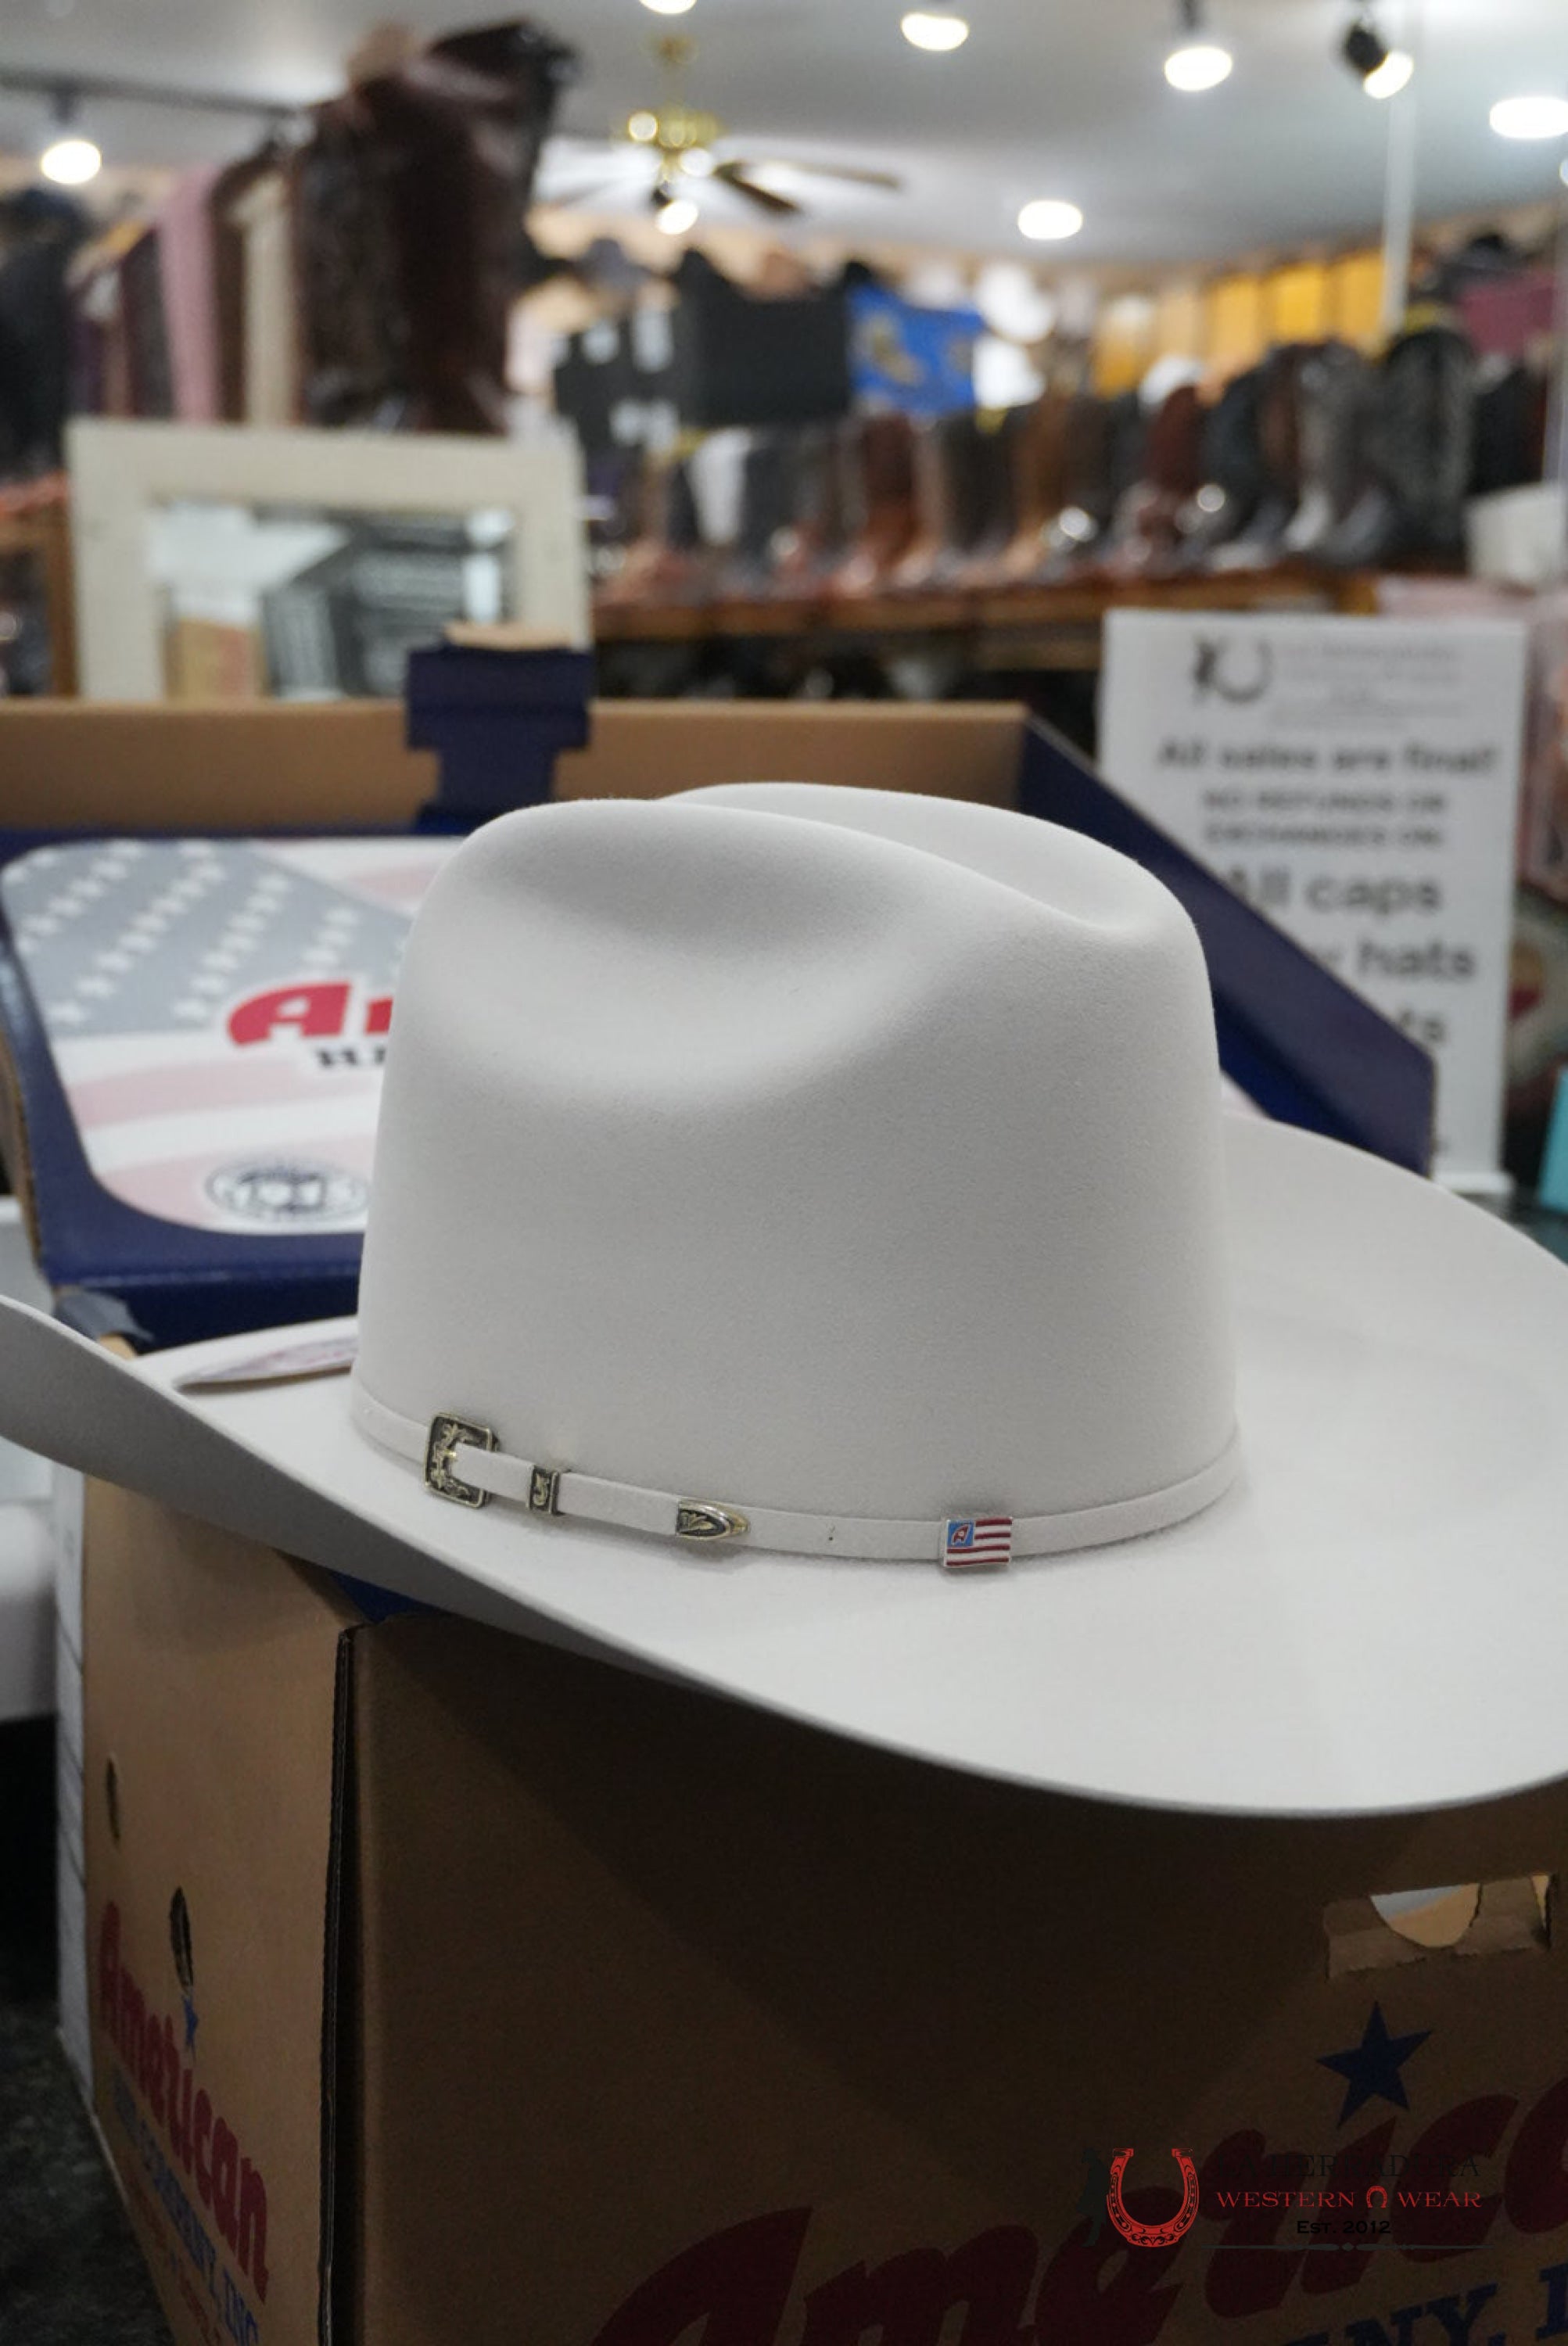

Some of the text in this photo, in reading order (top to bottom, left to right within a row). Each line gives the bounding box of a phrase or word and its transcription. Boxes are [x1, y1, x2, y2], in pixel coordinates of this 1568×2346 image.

[1332, 747, 1390, 771] are
[1305, 875, 1441, 914] caps
[1358, 940, 1477, 978] hats
